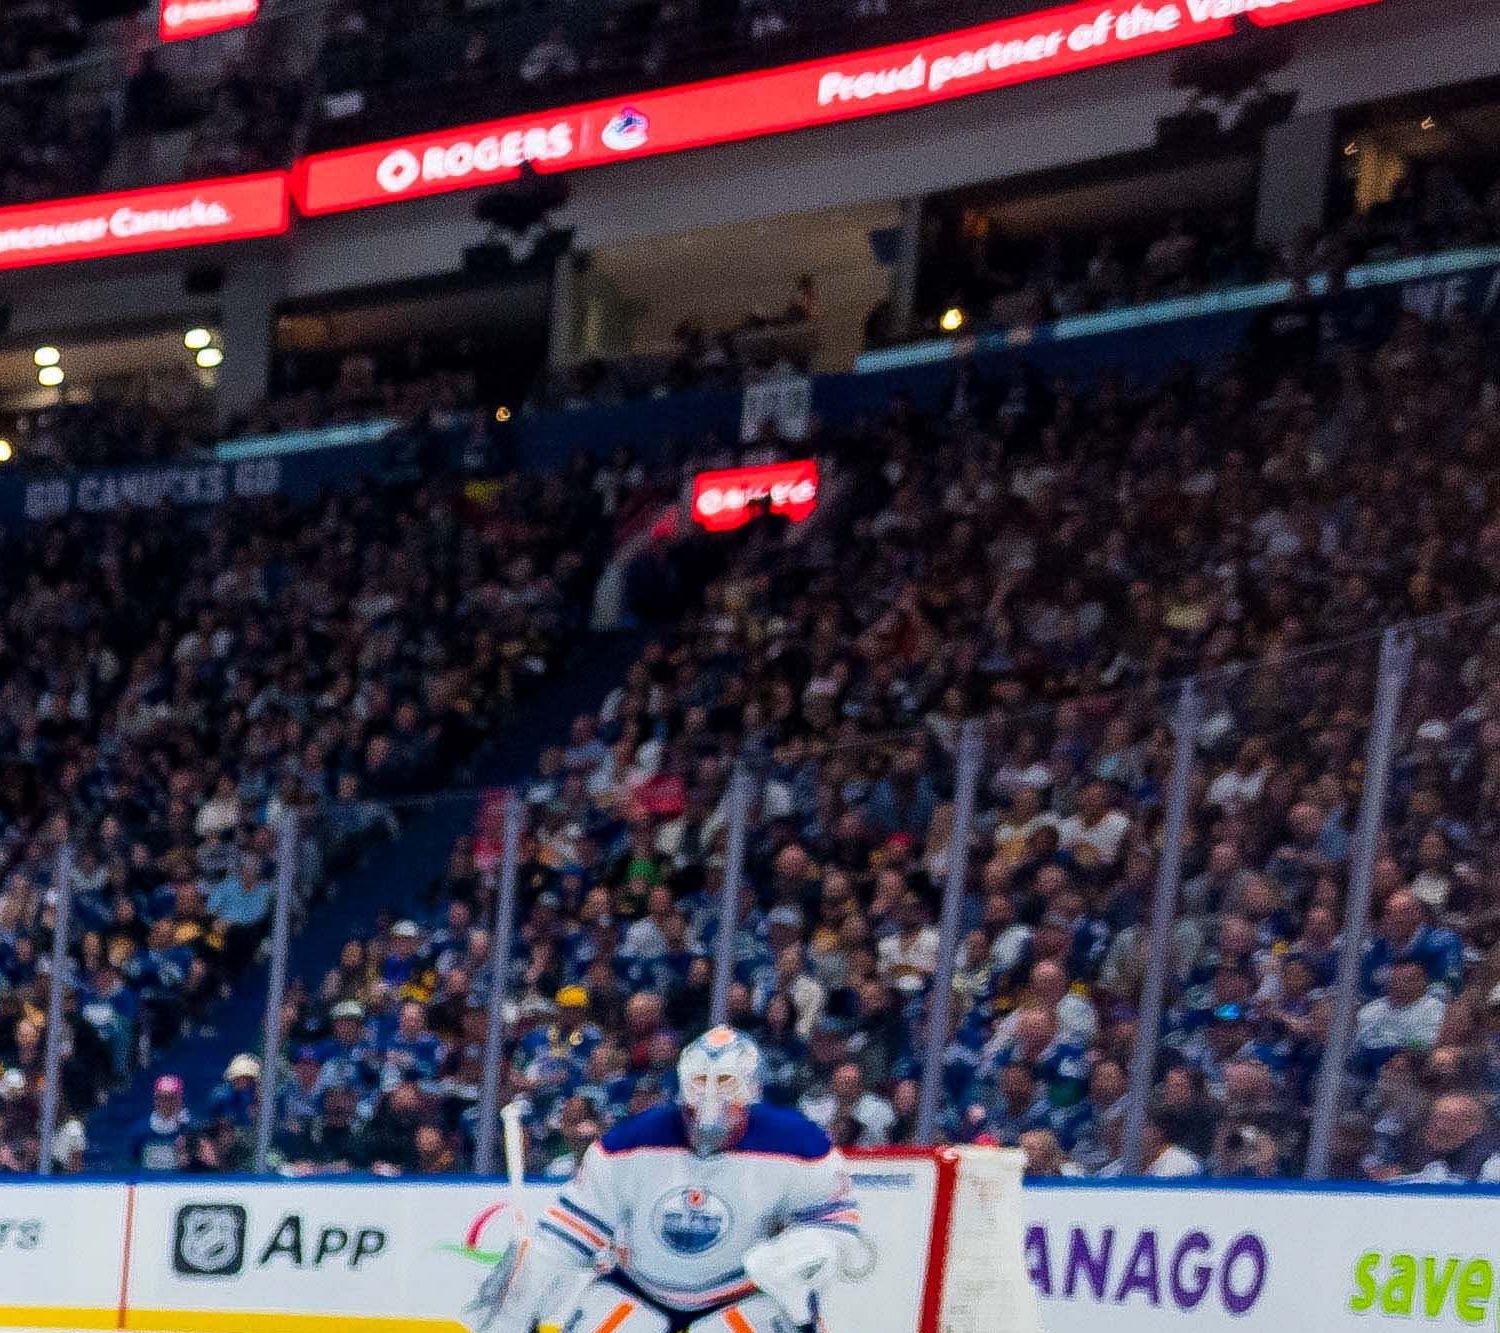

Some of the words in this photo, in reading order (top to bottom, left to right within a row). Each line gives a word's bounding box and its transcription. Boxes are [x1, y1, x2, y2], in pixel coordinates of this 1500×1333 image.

[817, 54, 926, 105] Proud
[927, 32, 1061, 91] partner
[1066, 8, 1111, 52] of
[1114, 3, 1182, 41] the
[422, 122, 573, 181] ROGERS
[1024, 1224, 1268, 1316] ANAGO
[1349, 1252, 1494, 1324] save
